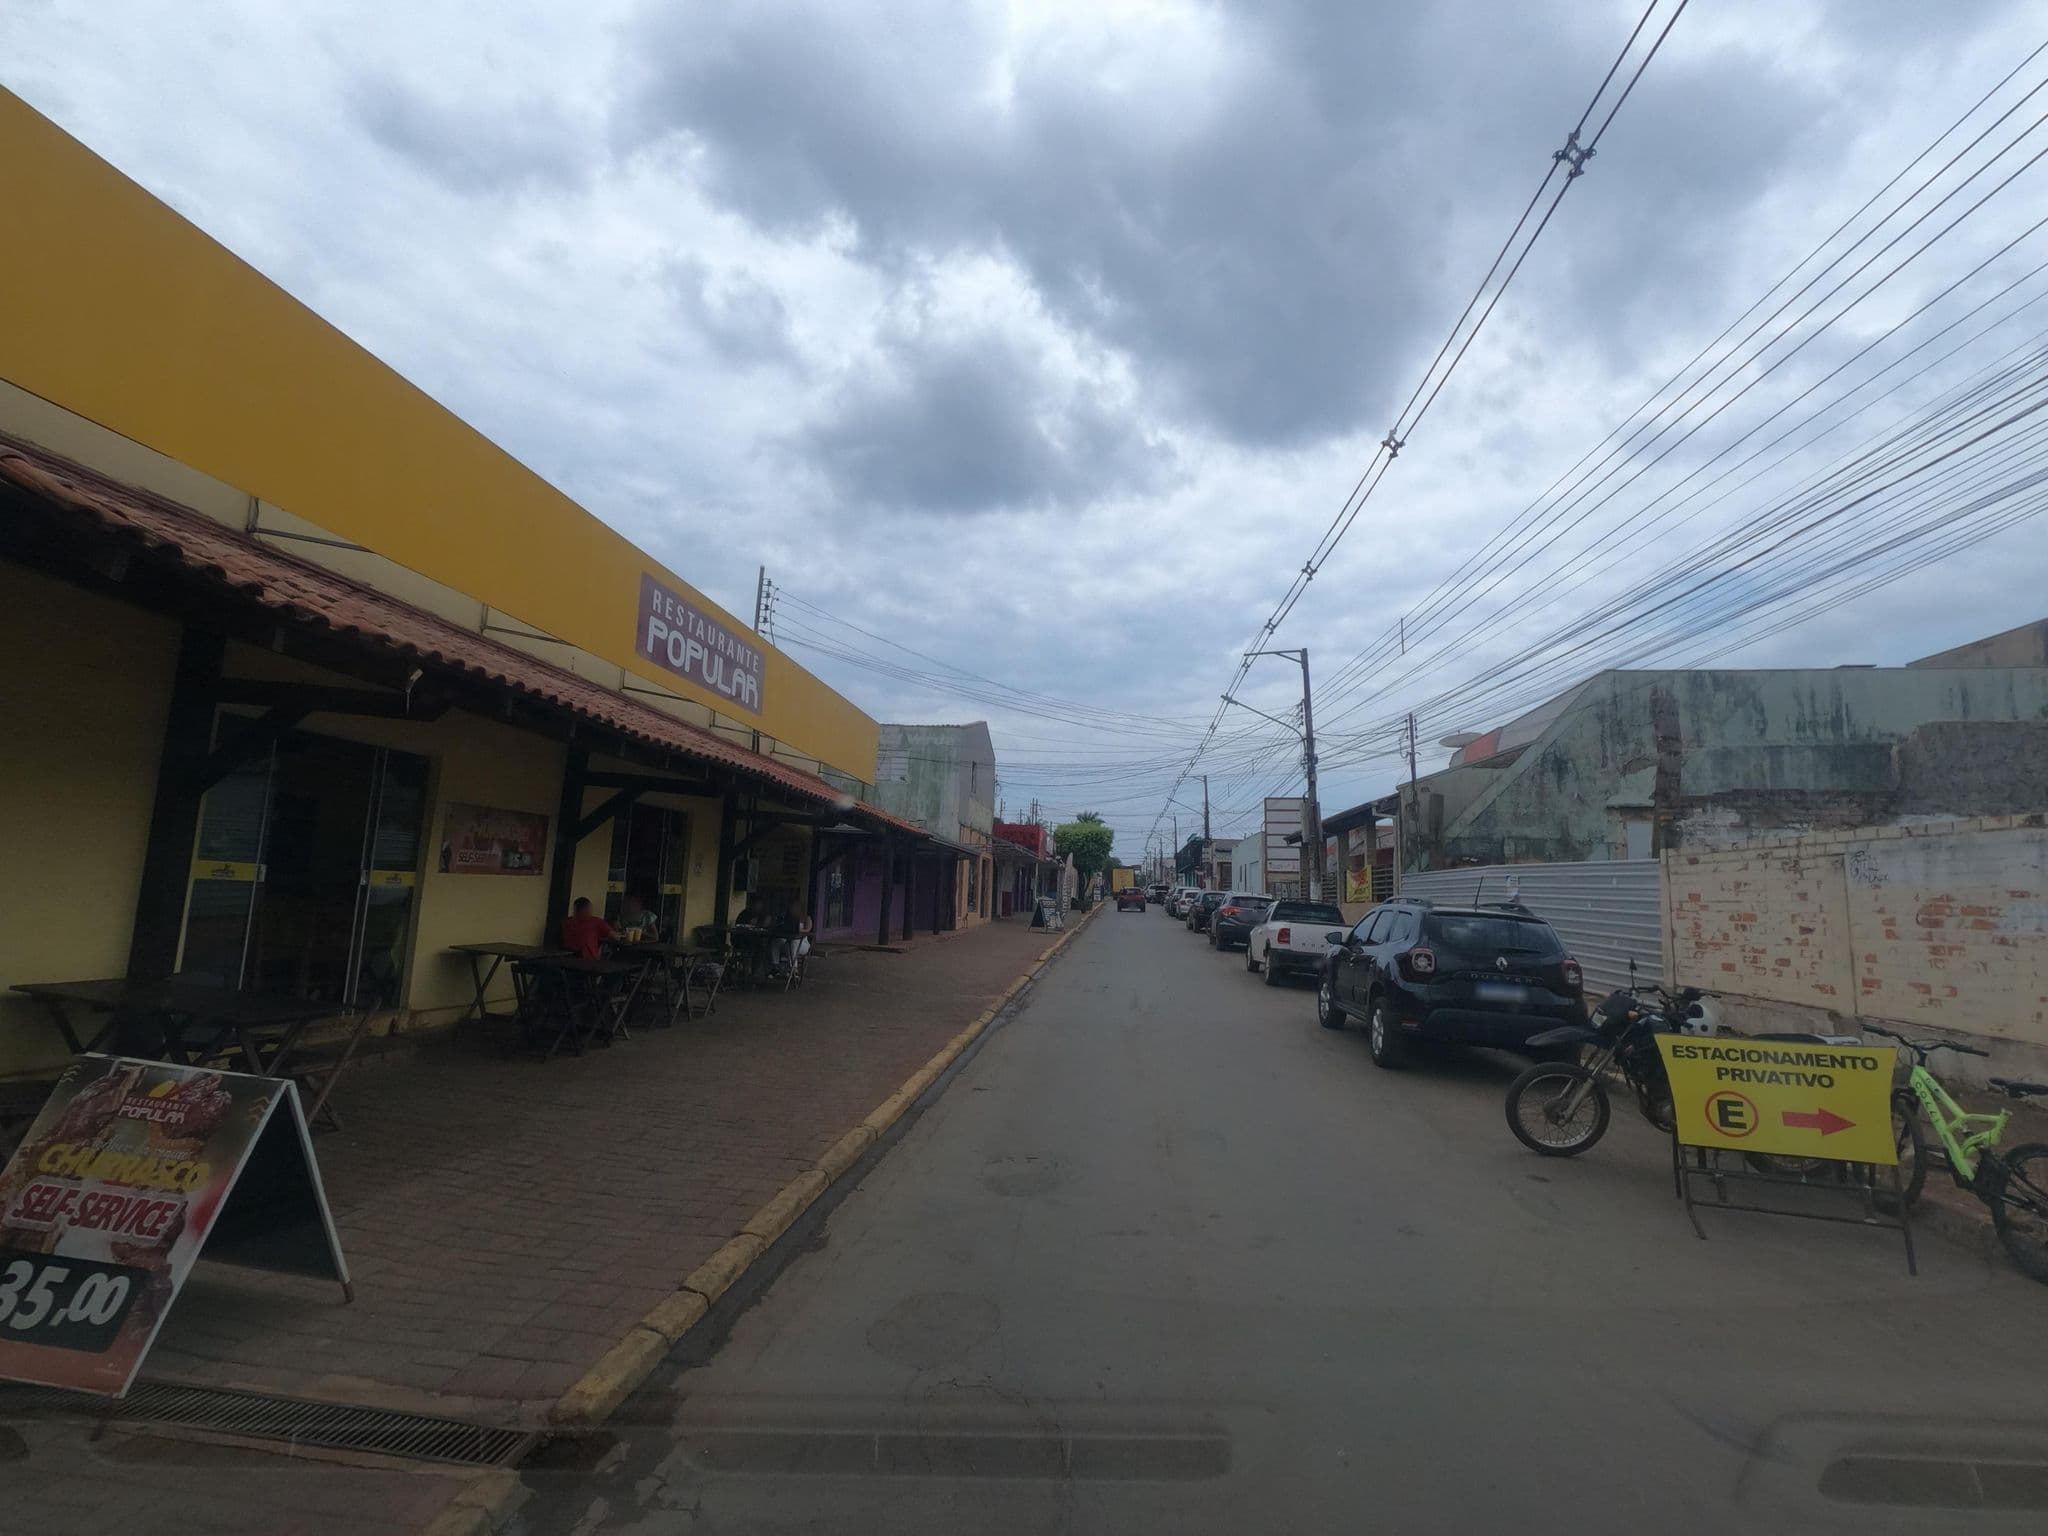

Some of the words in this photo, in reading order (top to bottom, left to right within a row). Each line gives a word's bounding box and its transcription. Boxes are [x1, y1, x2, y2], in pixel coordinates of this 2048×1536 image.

[652, 589, 760, 673] RESTAURANTE
[647, 615, 759, 709] POPULAR
[1671, 1044, 1878, 1071] ESTACIONAMENTO
[1716, 1066, 1835, 1088] PRIVATIVO
[118, 1105, 186, 1124] POPULAR
[1716, 1099, 1747, 1130] E
[12, 1183, 179, 1238] SELF-SERVICE
[0, 1259, 131, 1331] 35,00
